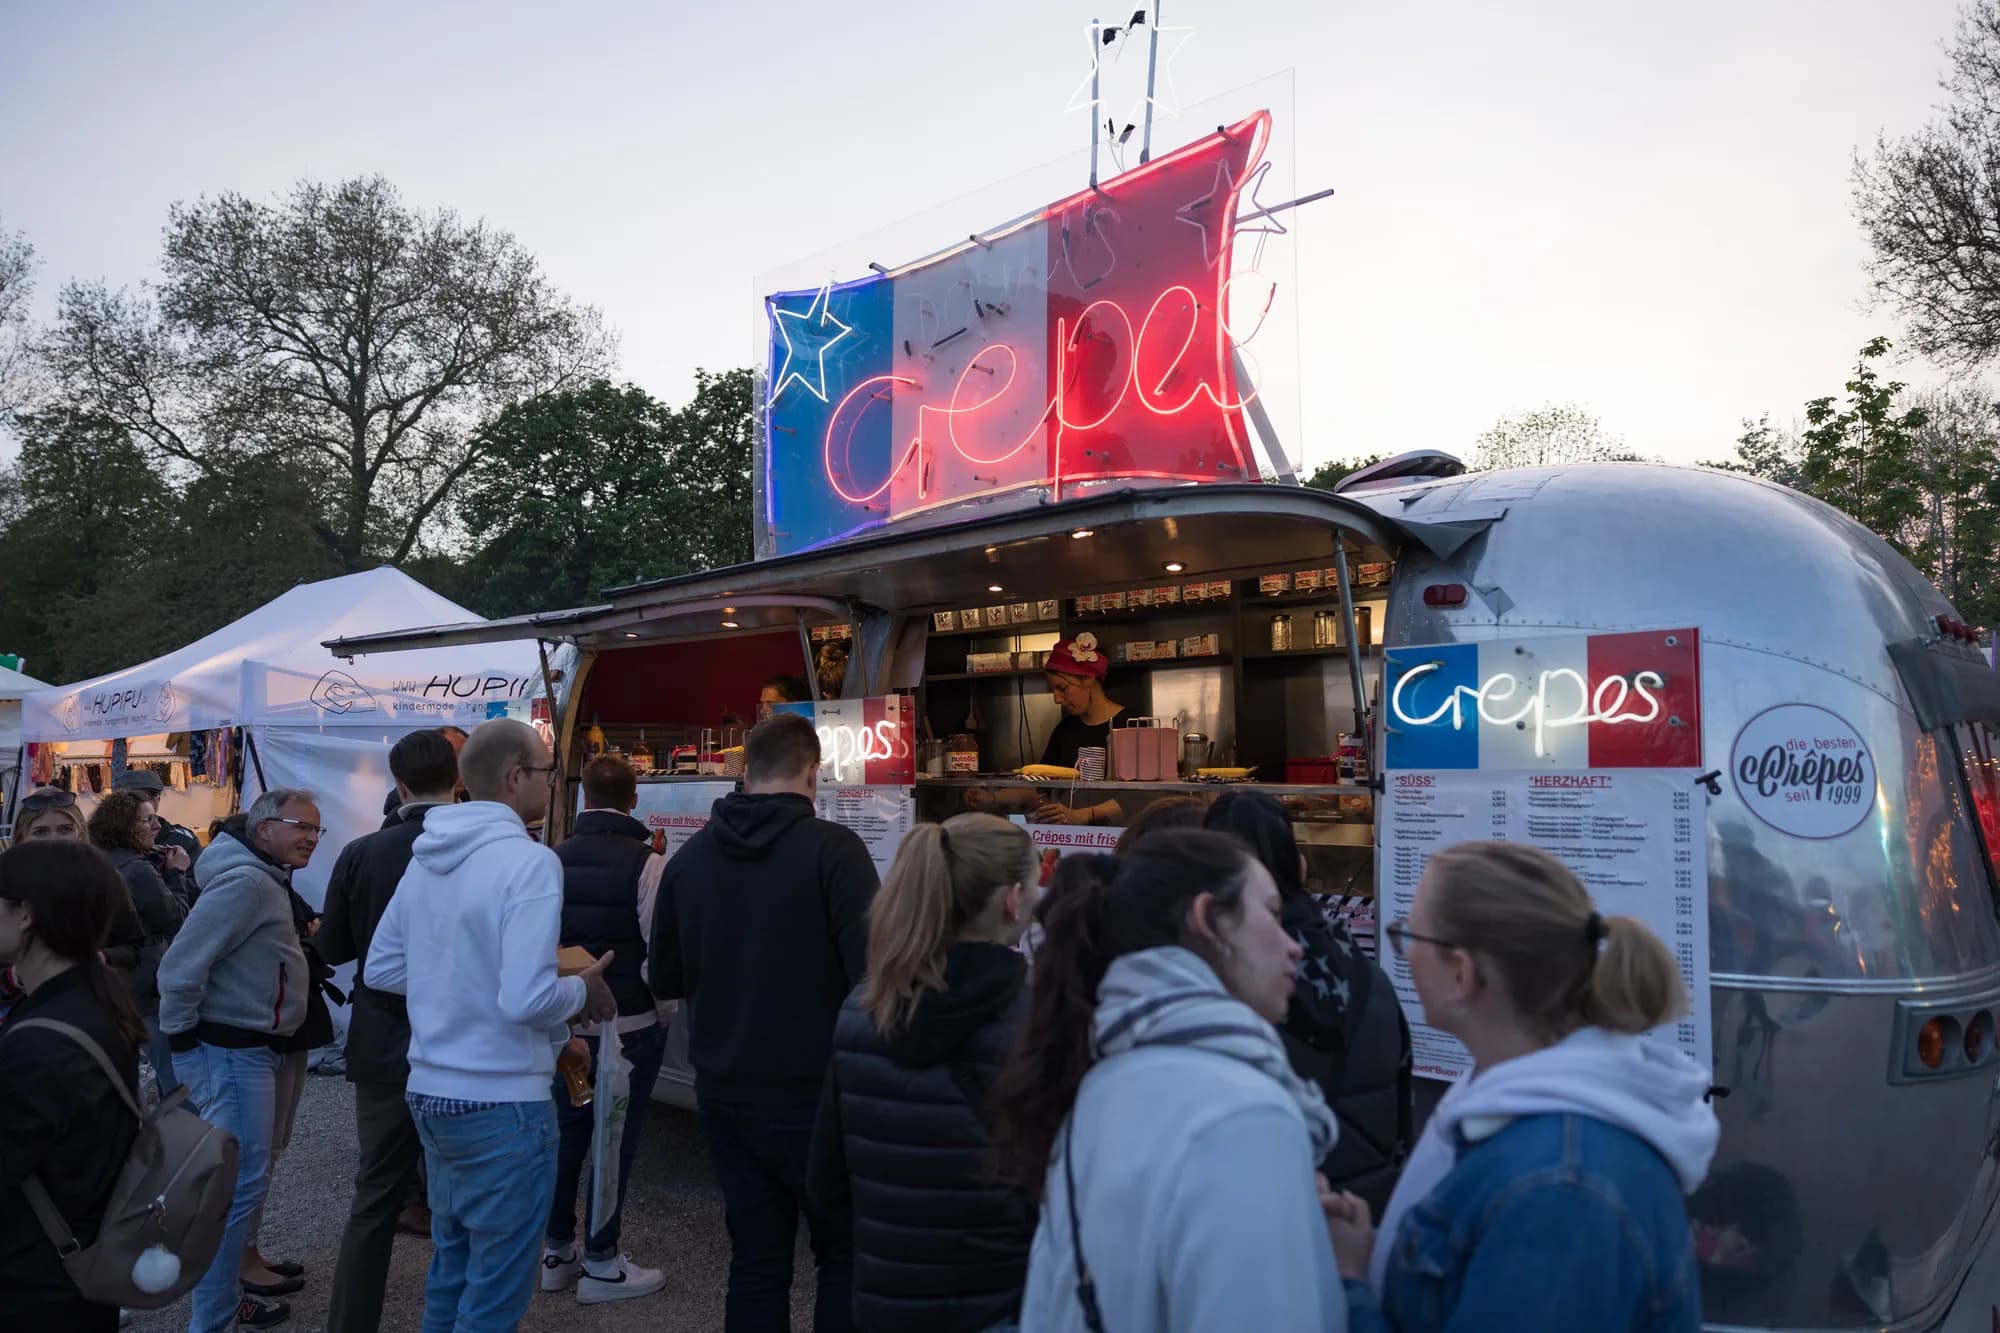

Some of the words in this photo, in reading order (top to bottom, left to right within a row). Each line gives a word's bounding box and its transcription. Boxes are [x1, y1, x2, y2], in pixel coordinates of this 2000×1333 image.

[392, 702, 455, 711] kindermode
[1392, 663, 1664, 759] Crepes
[1786, 738, 1807, 750] die
[1814, 736, 1857, 750] besten
[1740, 745, 1865, 801] Crêpes
[1785, 788, 1811, 802] seit
[1827, 785, 1862, 805] 1999
[1032, 830, 1071, 844] Crêpes
[1075, 833, 1093, 844] mit
